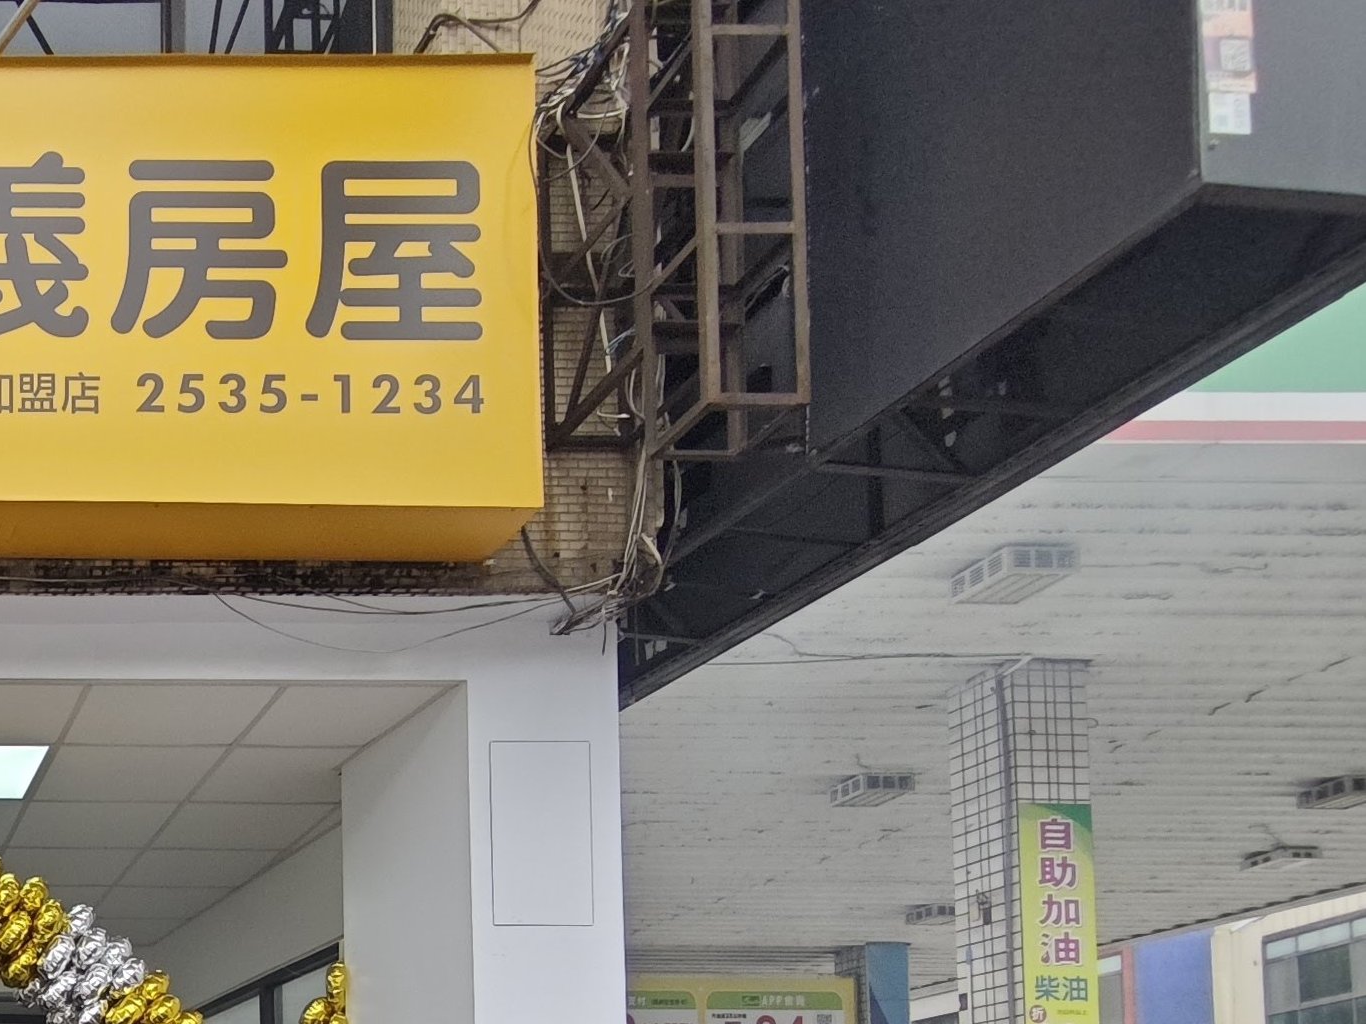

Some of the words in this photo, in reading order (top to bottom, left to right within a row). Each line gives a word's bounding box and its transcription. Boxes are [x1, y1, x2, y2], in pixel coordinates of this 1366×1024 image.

[136, 373, 485, 414] 2535-1234
[1039, 818, 1080, 964] 自助加油
[1035, 975, 1088, 1001] 柴油
